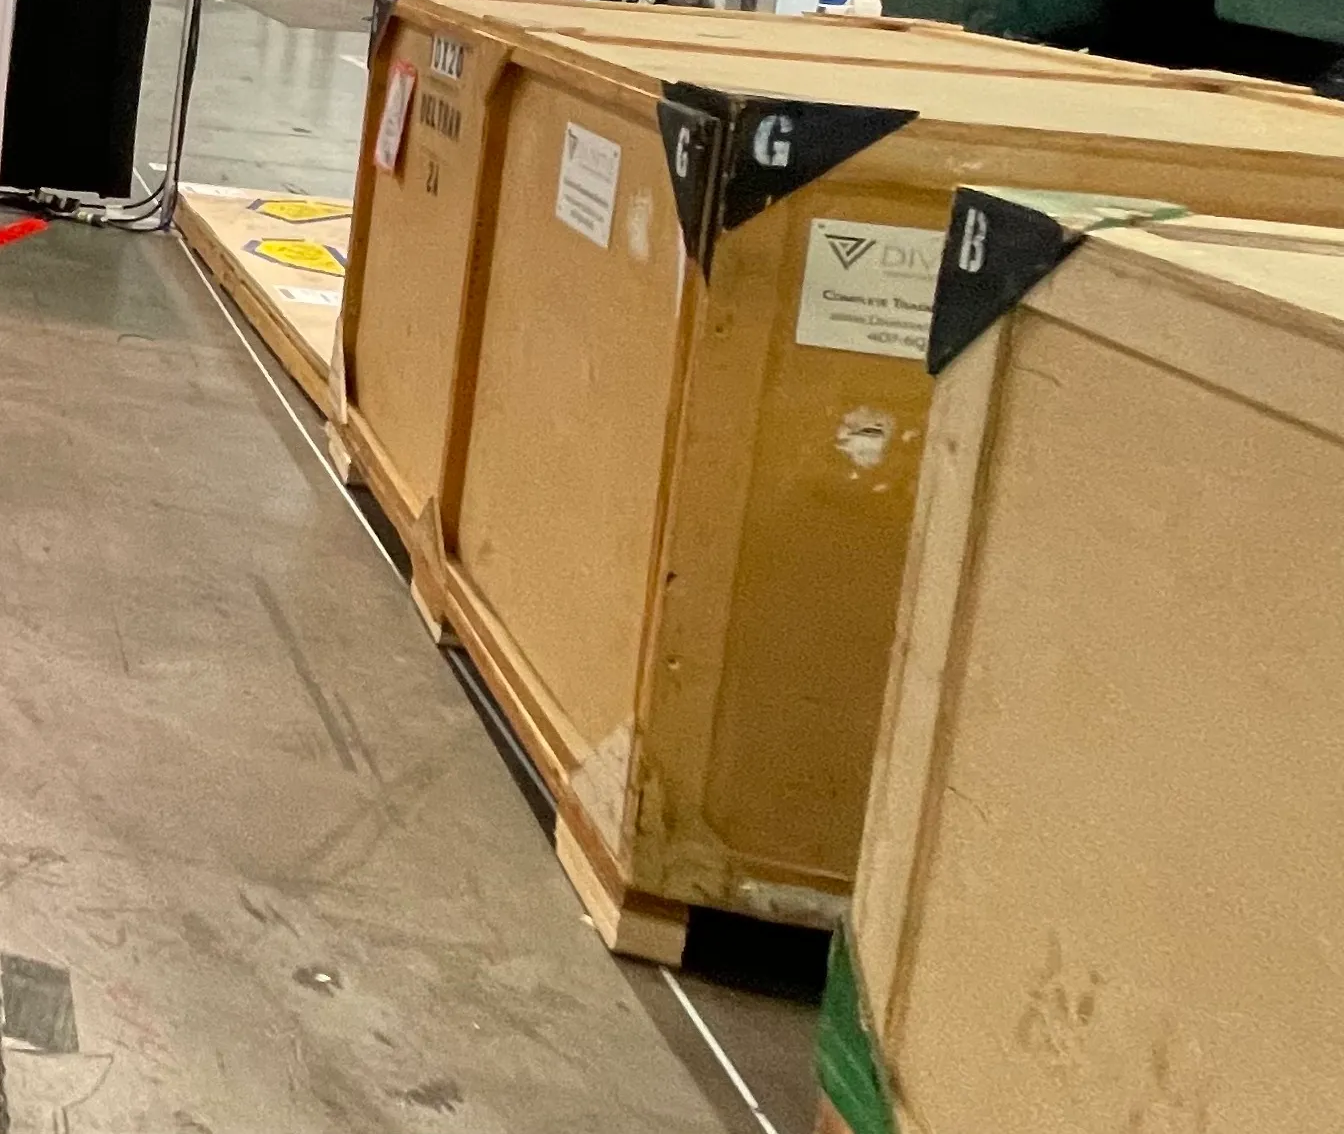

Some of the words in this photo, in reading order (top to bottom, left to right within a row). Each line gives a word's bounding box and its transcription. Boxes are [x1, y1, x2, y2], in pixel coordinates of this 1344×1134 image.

[420, 93, 462, 142] DELTRAN
[753, 115, 793, 167] G
[675, 127, 689, 178] G
[958, 207, 988, 273] B
